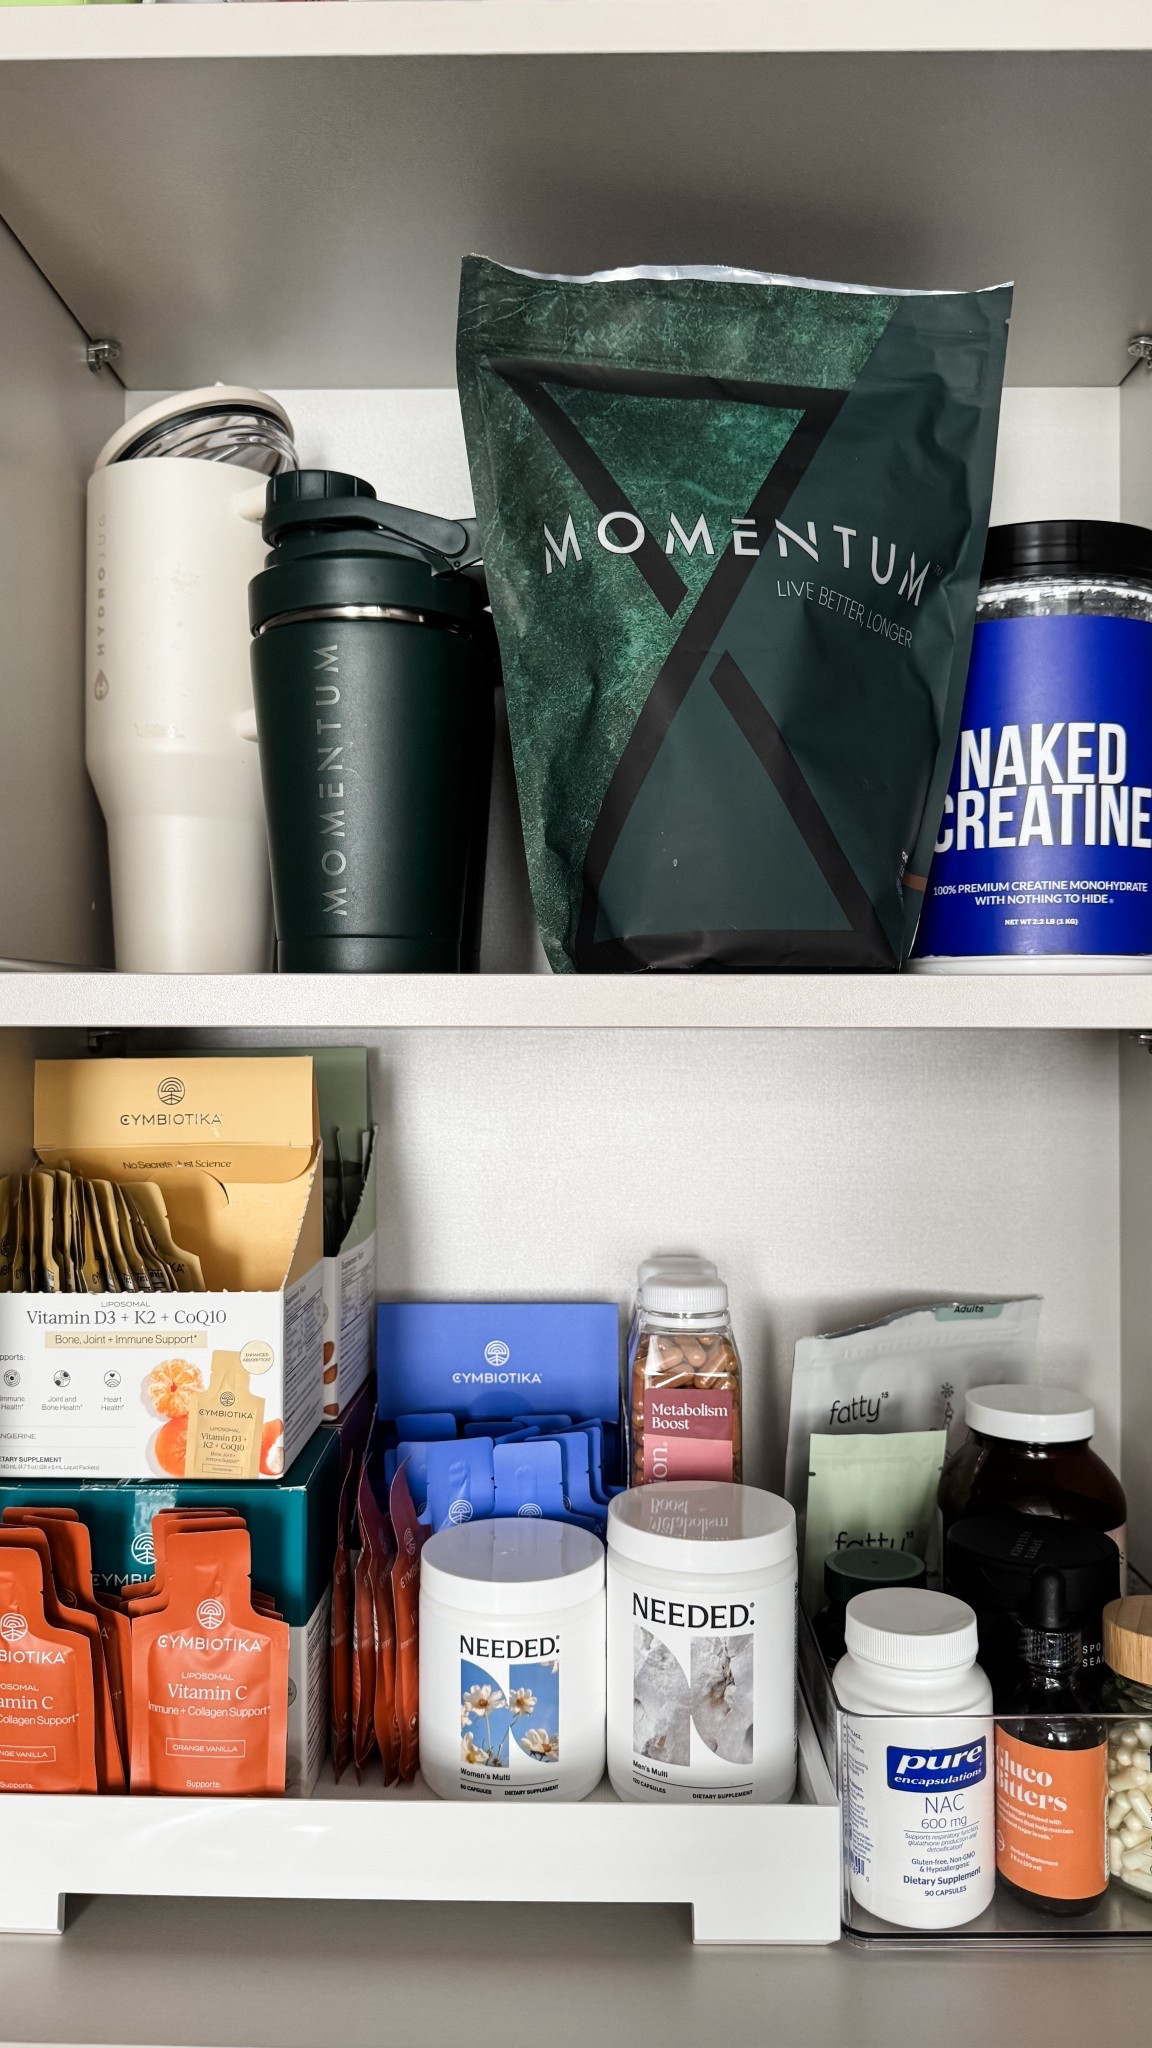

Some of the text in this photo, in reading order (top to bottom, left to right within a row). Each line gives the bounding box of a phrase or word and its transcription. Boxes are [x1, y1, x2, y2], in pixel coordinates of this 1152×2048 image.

[543, 510, 932, 607] MOMENTUM
[97, 514, 107, 656] HYDROJUG
[777, 580, 913, 648] LIVE BETTER, LONGER
[960, 722, 1127, 790] NAKED
[313, 643, 348, 916] MOMENTUM
[933, 784, 1152, 854] CREATINE
[933, 880, 1149, 896] 100% PREMIUM CREATINE MONOHYDRATE
[974, 894, 1005, 906] WITH
[1007, 893, 1063, 905] NOTHING
[1064, 893, 1080, 904] TO
[1004, 918, 1019, 926] NET
[1020, 918, 1031, 926] WT
[120, 1113, 222, 1126] CYMBIOTIKA
[122, 1161, 138, 1170] No
[195, 1159, 232, 1168] Science
[953, 1304, 984, 1313] Adults
[26, 1309, 227, 1327] Vitamin D3 + K2 + CoQ10
[55, 1335, 82, 1346] Bone,
[83, 1335, 106, 1344] Joint
[115, 1335, 154, 1344] Immune
[452, 1372, 542, 1384] CYMBIOTIKA
[198, 1408, 254, 1420] CYMBIOTIKA
[651, 1403, 729, 1417] Metabolism
[651, 1417, 690, 1430] Boost
[201, 1432, 230, 1442] Vitamin
[203, 1441, 214, 1449] K2
[157, 1634, 263, 1652] CYMBIOTIKA
[1082, 1655, 1105, 1668] SEA
[181, 1671, 235, 1681] LIPOSOMAL
[168, 1683, 248, 1701] Vitamin C
[41, 1695, 54, 1710] C
[148, 1700, 179, 1715] Immune
[187, 1705, 228, 1719] Collagen
[172, 1744, 238, 1753] ORANGE VANILLA
[632, 1759, 651, 1773] Men's
[896, 1745, 983, 1775] pure
[996, 1744, 1053, 1788] Gluco
[460, 1767, 511, 1781] Women's Multi
[894, 1767, 982, 1788] encapsulations
[186, 1779, 222, 1789] Supports:
[466, 1785, 492, 1795] CAPSULES
[526, 1784, 559, 1795] SUPPLEMENT
[640, 1780, 667, 1794] CAPSULES
[692, 1789, 754, 1800] DIETARY SUPPLEMENT
[925, 1793, 965, 1814] NAC
[921, 1815, 967, 1829] 600 mg
[904, 1832, 931, 1840] Supports
[949, 1850, 976, 1863] Non-GMO
[919, 1860, 970, 1873] & Hypoallergenic
[903, 1866, 981, 1887] Dietary Supplement
[935, 1885, 967, 1896] CAPSULES
